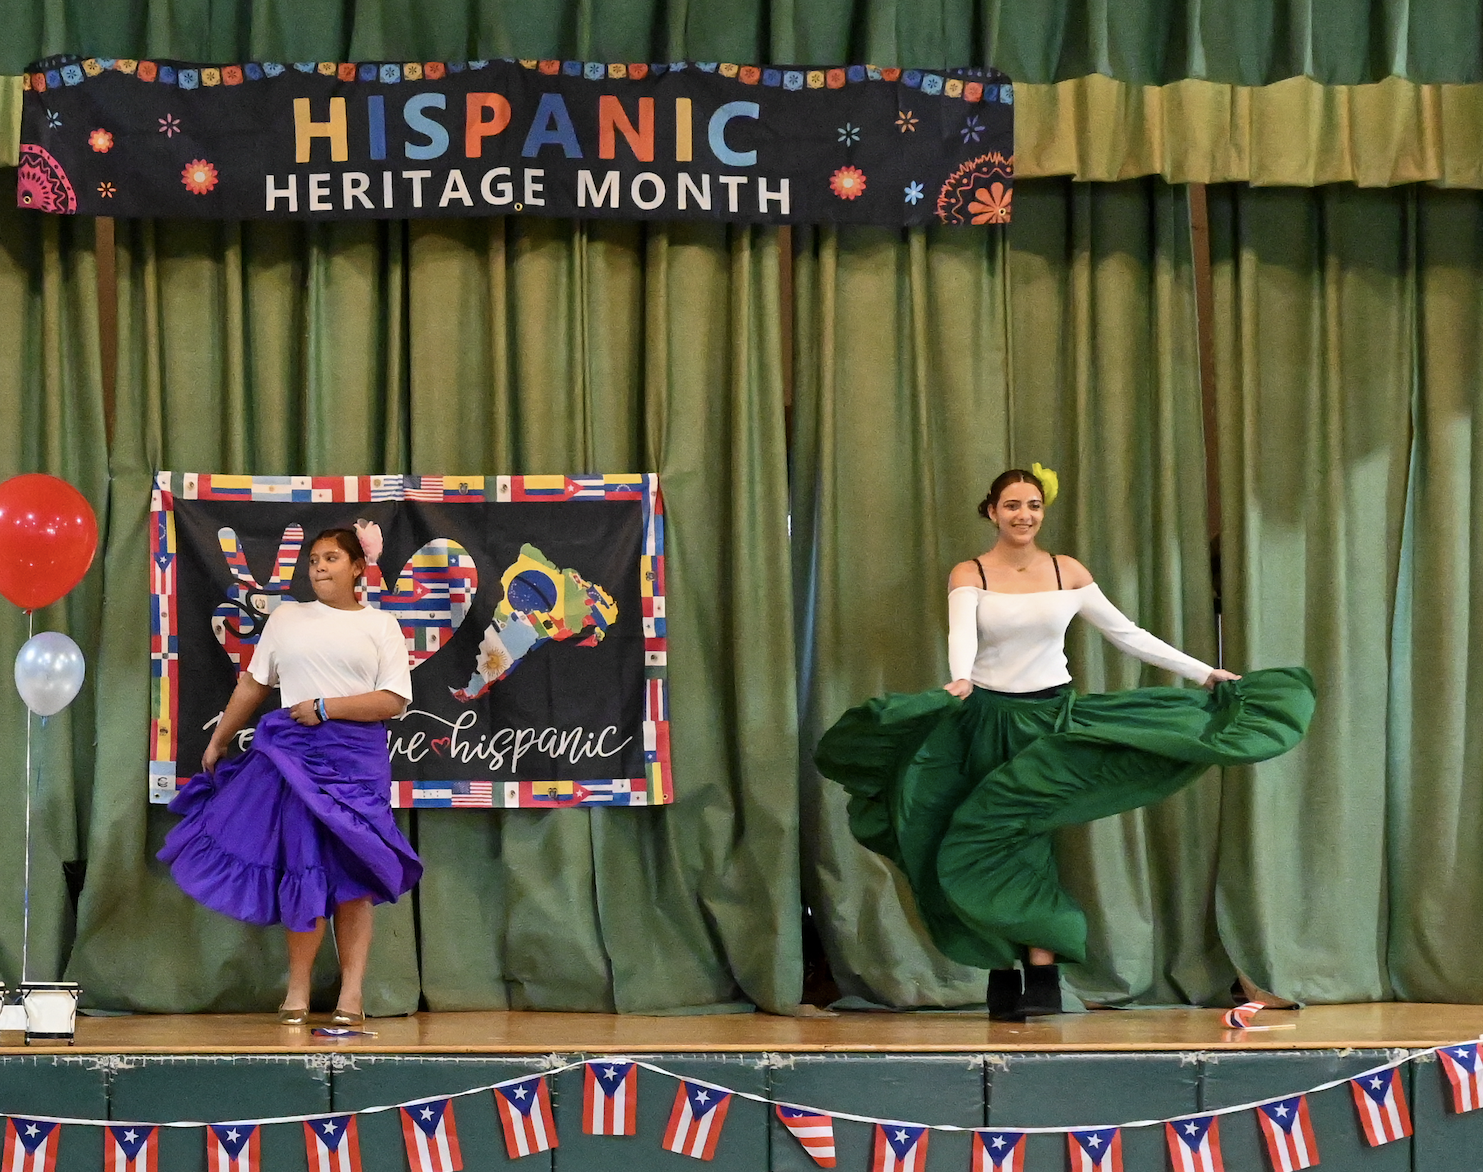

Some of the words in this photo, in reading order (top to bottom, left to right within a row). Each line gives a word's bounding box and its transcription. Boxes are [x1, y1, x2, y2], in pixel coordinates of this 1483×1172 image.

[293, 92, 760, 167] HISPANIC
[264, 166, 545, 213] HERITAGE
[577, 169, 790, 215] MONTH
[400, 709, 633, 774] hispanic
